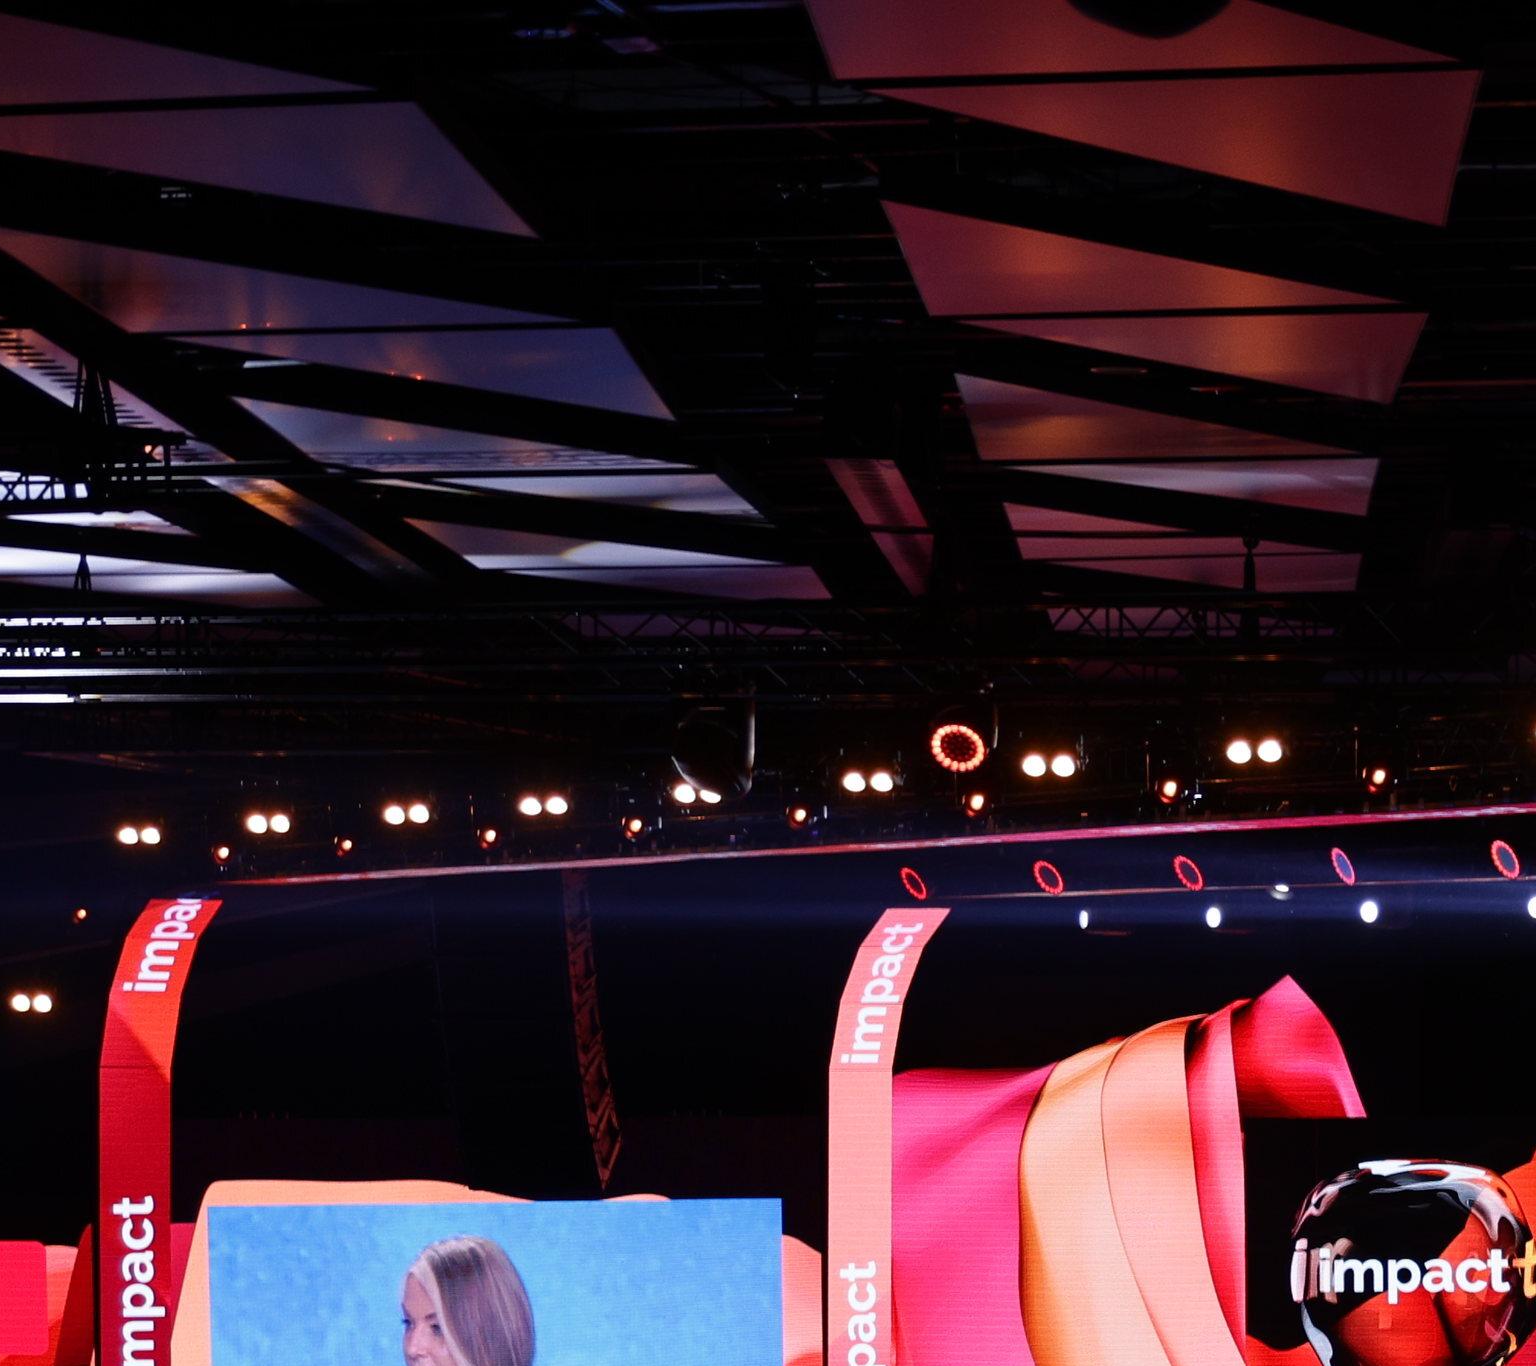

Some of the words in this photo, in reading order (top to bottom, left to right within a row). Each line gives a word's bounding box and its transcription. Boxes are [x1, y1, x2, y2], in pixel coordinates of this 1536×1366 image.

[123, 898, 202, 992] impa
[841, 923, 923, 1064] impact
[1318, 1247, 1511, 1305] impact
